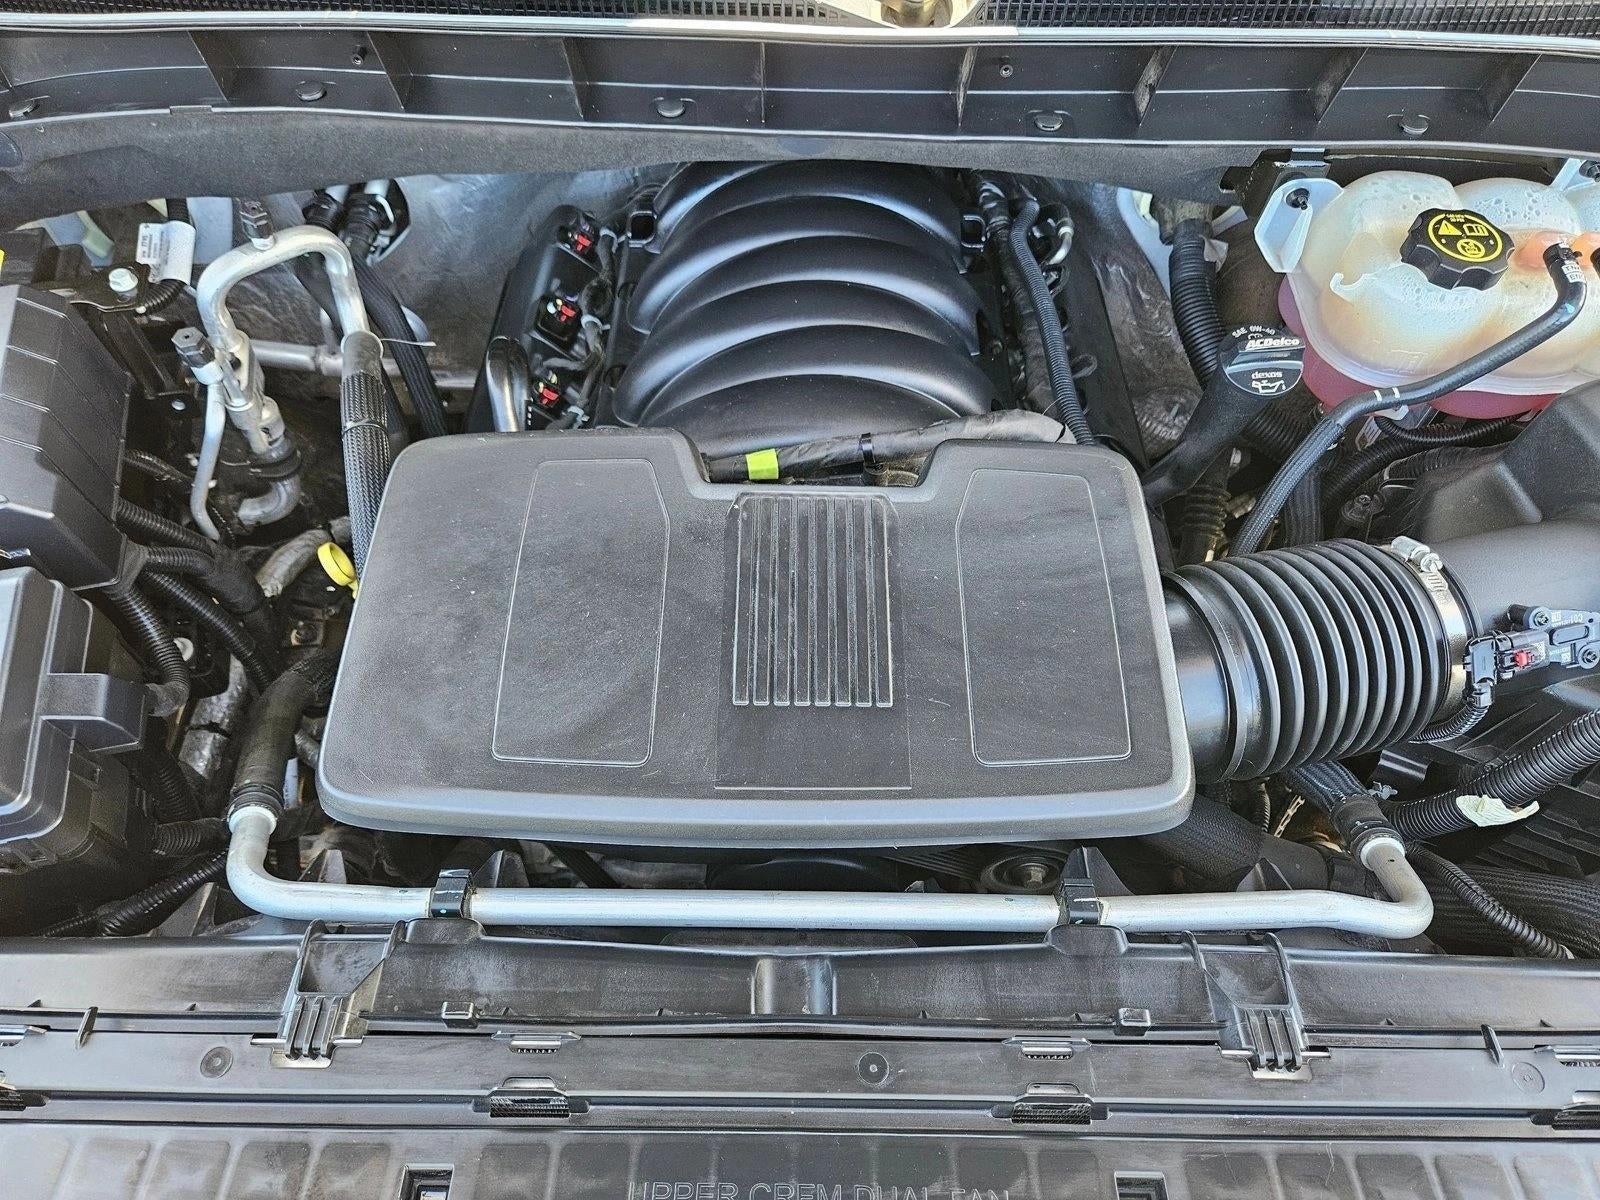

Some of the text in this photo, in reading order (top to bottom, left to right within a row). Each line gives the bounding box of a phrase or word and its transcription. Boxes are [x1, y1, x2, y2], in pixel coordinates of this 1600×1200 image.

[1232, 325, 1276, 338] SAE 0W-40
[1245, 337, 1300, 351] ACDelco
[1251, 371, 1283, 380] dexos
[628, 1181, 739, 1200] UPPER
